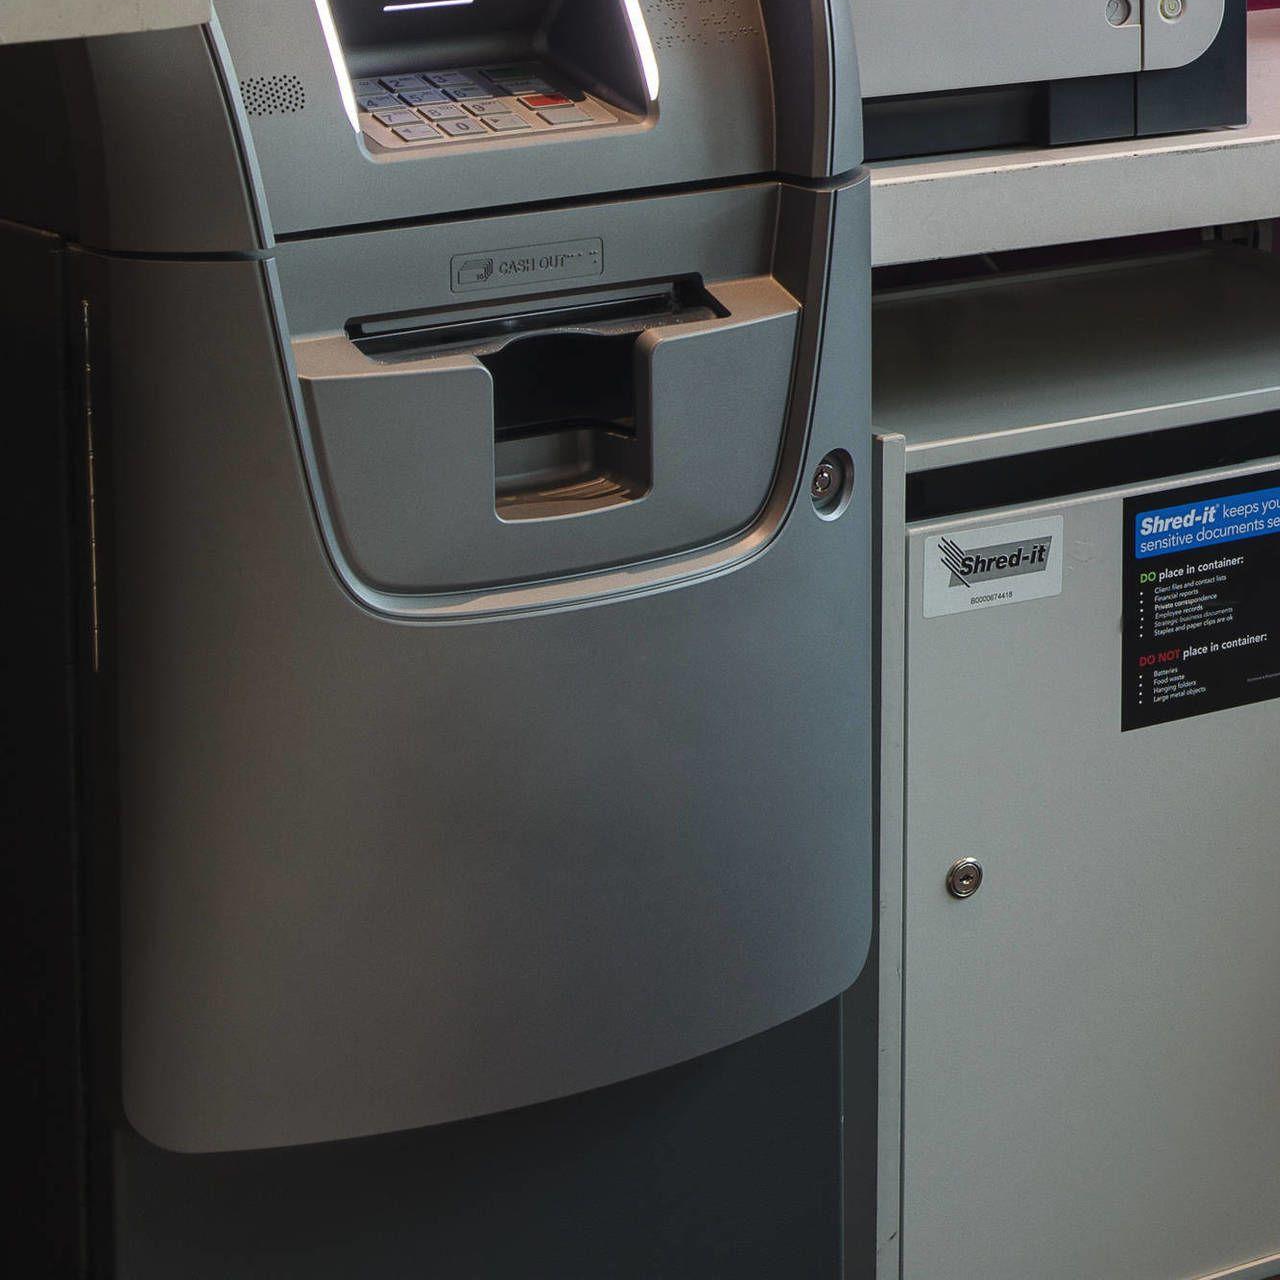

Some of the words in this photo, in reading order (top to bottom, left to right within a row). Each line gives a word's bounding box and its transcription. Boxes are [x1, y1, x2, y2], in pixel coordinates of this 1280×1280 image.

[499, 258, 535, 276] CASH
[539, 253, 566, 271] OUT
[1222, 502, 1259, 520] keeps
[1140, 532, 1194, 553] sensitive
[1196, 519, 1265, 543] documents
[960, 544, 1046, 576] Shred-it
[1139, 571, 1157, 584] DO
[1158, 568, 1184, 583] place
[1186, 564, 1195, 574] in
[1197, 556, 1244, 573] container:
[1155, 586, 1170, 594] Client
[1172, 583, 1183, 591] files
[1195, 577, 1215, 586] contact
[1154, 591, 1178, 601] Financial
[1179, 588, 1199, 598] reports
[1154, 602, 1174, 611] Private
[1155, 609, 1181, 620] Employee
[1183, 604, 1203, 613] records
[1154, 626, 1175, 637] Staples
[1175, 624, 1186, 632] and
[1186, 621, 1202, 631] paper
[1139, 654, 1156, 667] DO
[1158, 648, 1181, 661] NOT
[1183, 645, 1208, 660] place
[1210, 642, 1219, 652] in
[1221, 633, 1268, 650] container:
[1153, 667, 1178, 677] Batteries
[1153, 677, 1169, 686] Food
[1169, 673, 1185, 683] waste
[1153, 684, 1177, 695] Hanging
[1178, 679, 1196, 689] folders
[1153, 694, 1169, 704] Large
[1169, 690, 1185, 700] metal
[1186, 686, 1206, 697] objects
